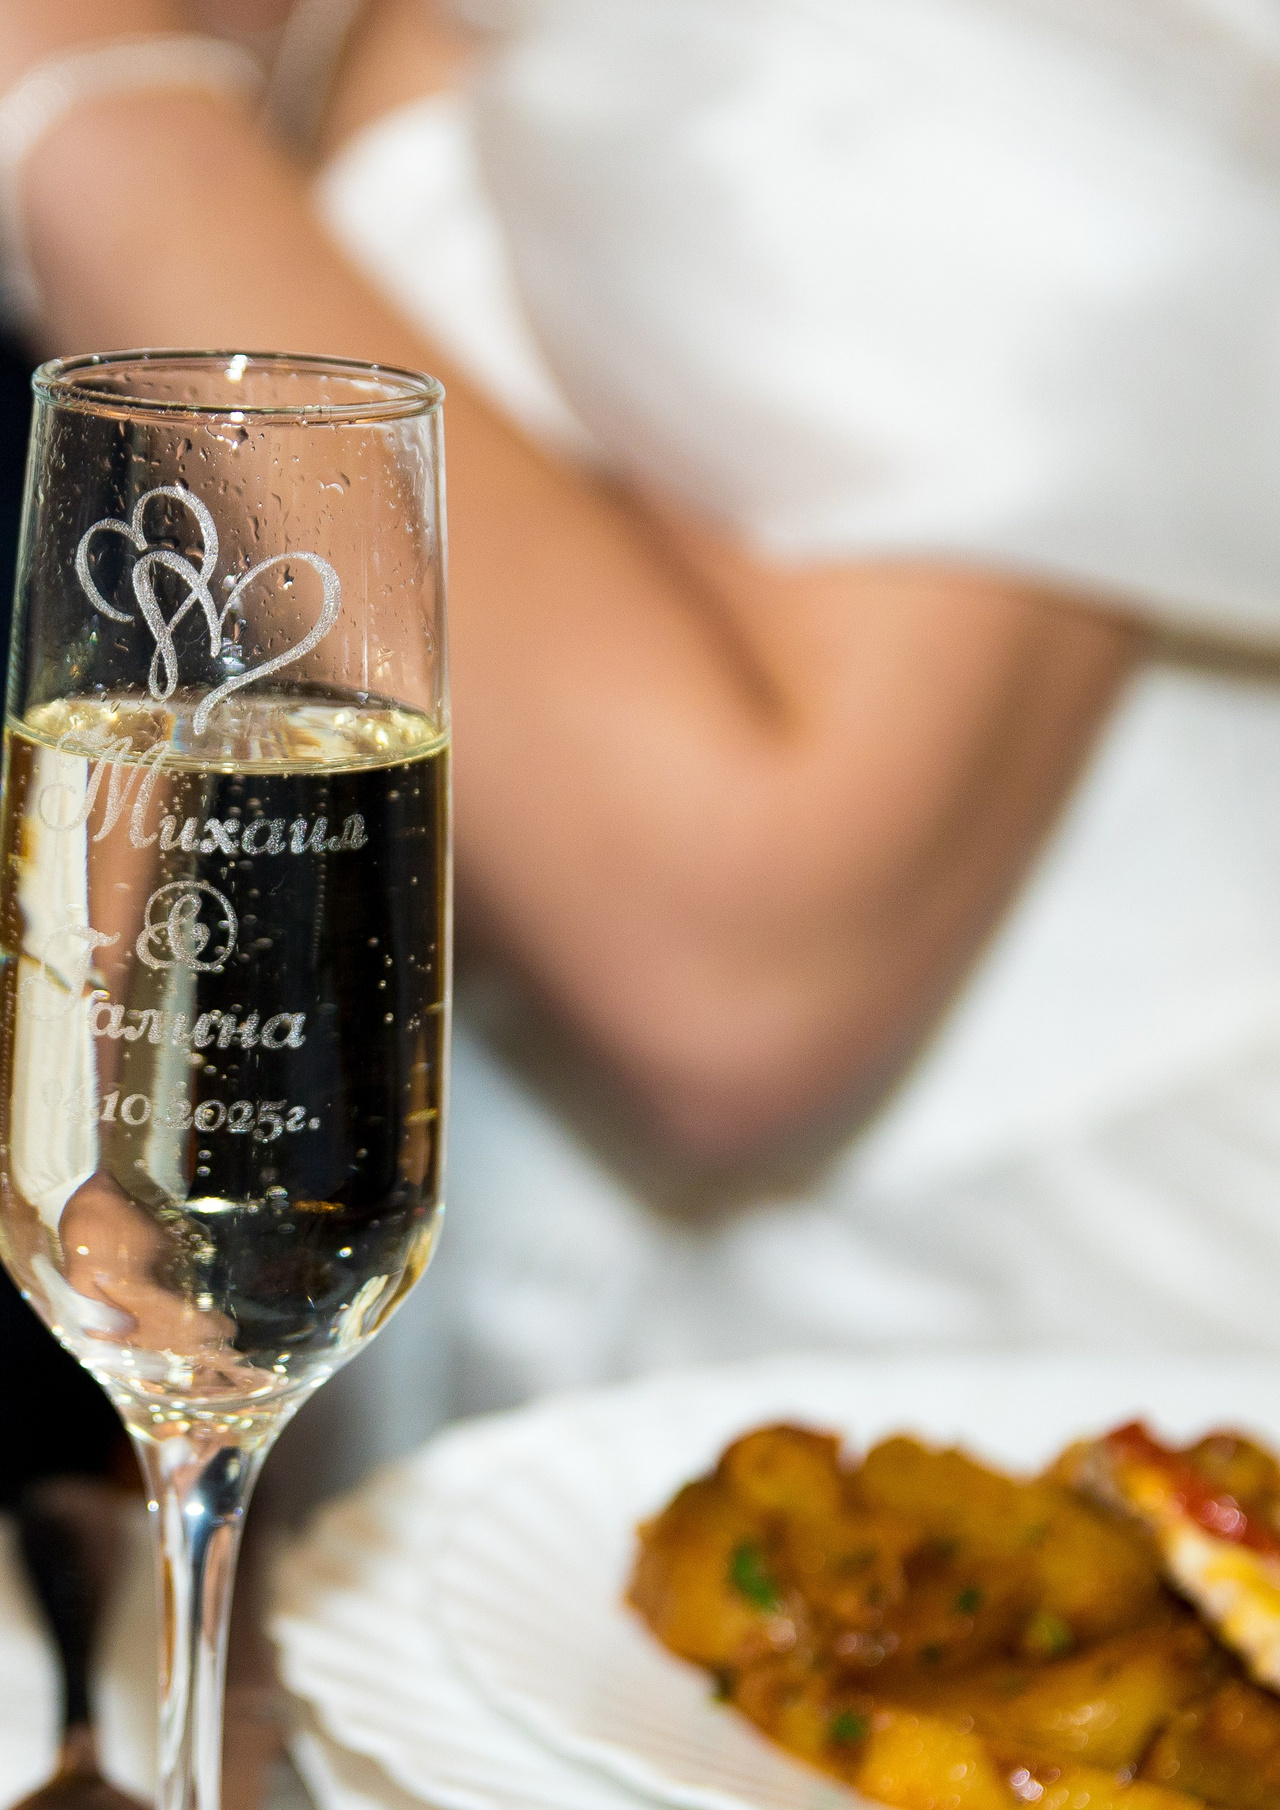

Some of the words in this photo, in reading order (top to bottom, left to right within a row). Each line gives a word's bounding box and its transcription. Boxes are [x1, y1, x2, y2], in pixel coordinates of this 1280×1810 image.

[38, 729, 369, 856] Михаил
[20, 923, 307, 1050] Галина
[135, 879, 238, 972] &
